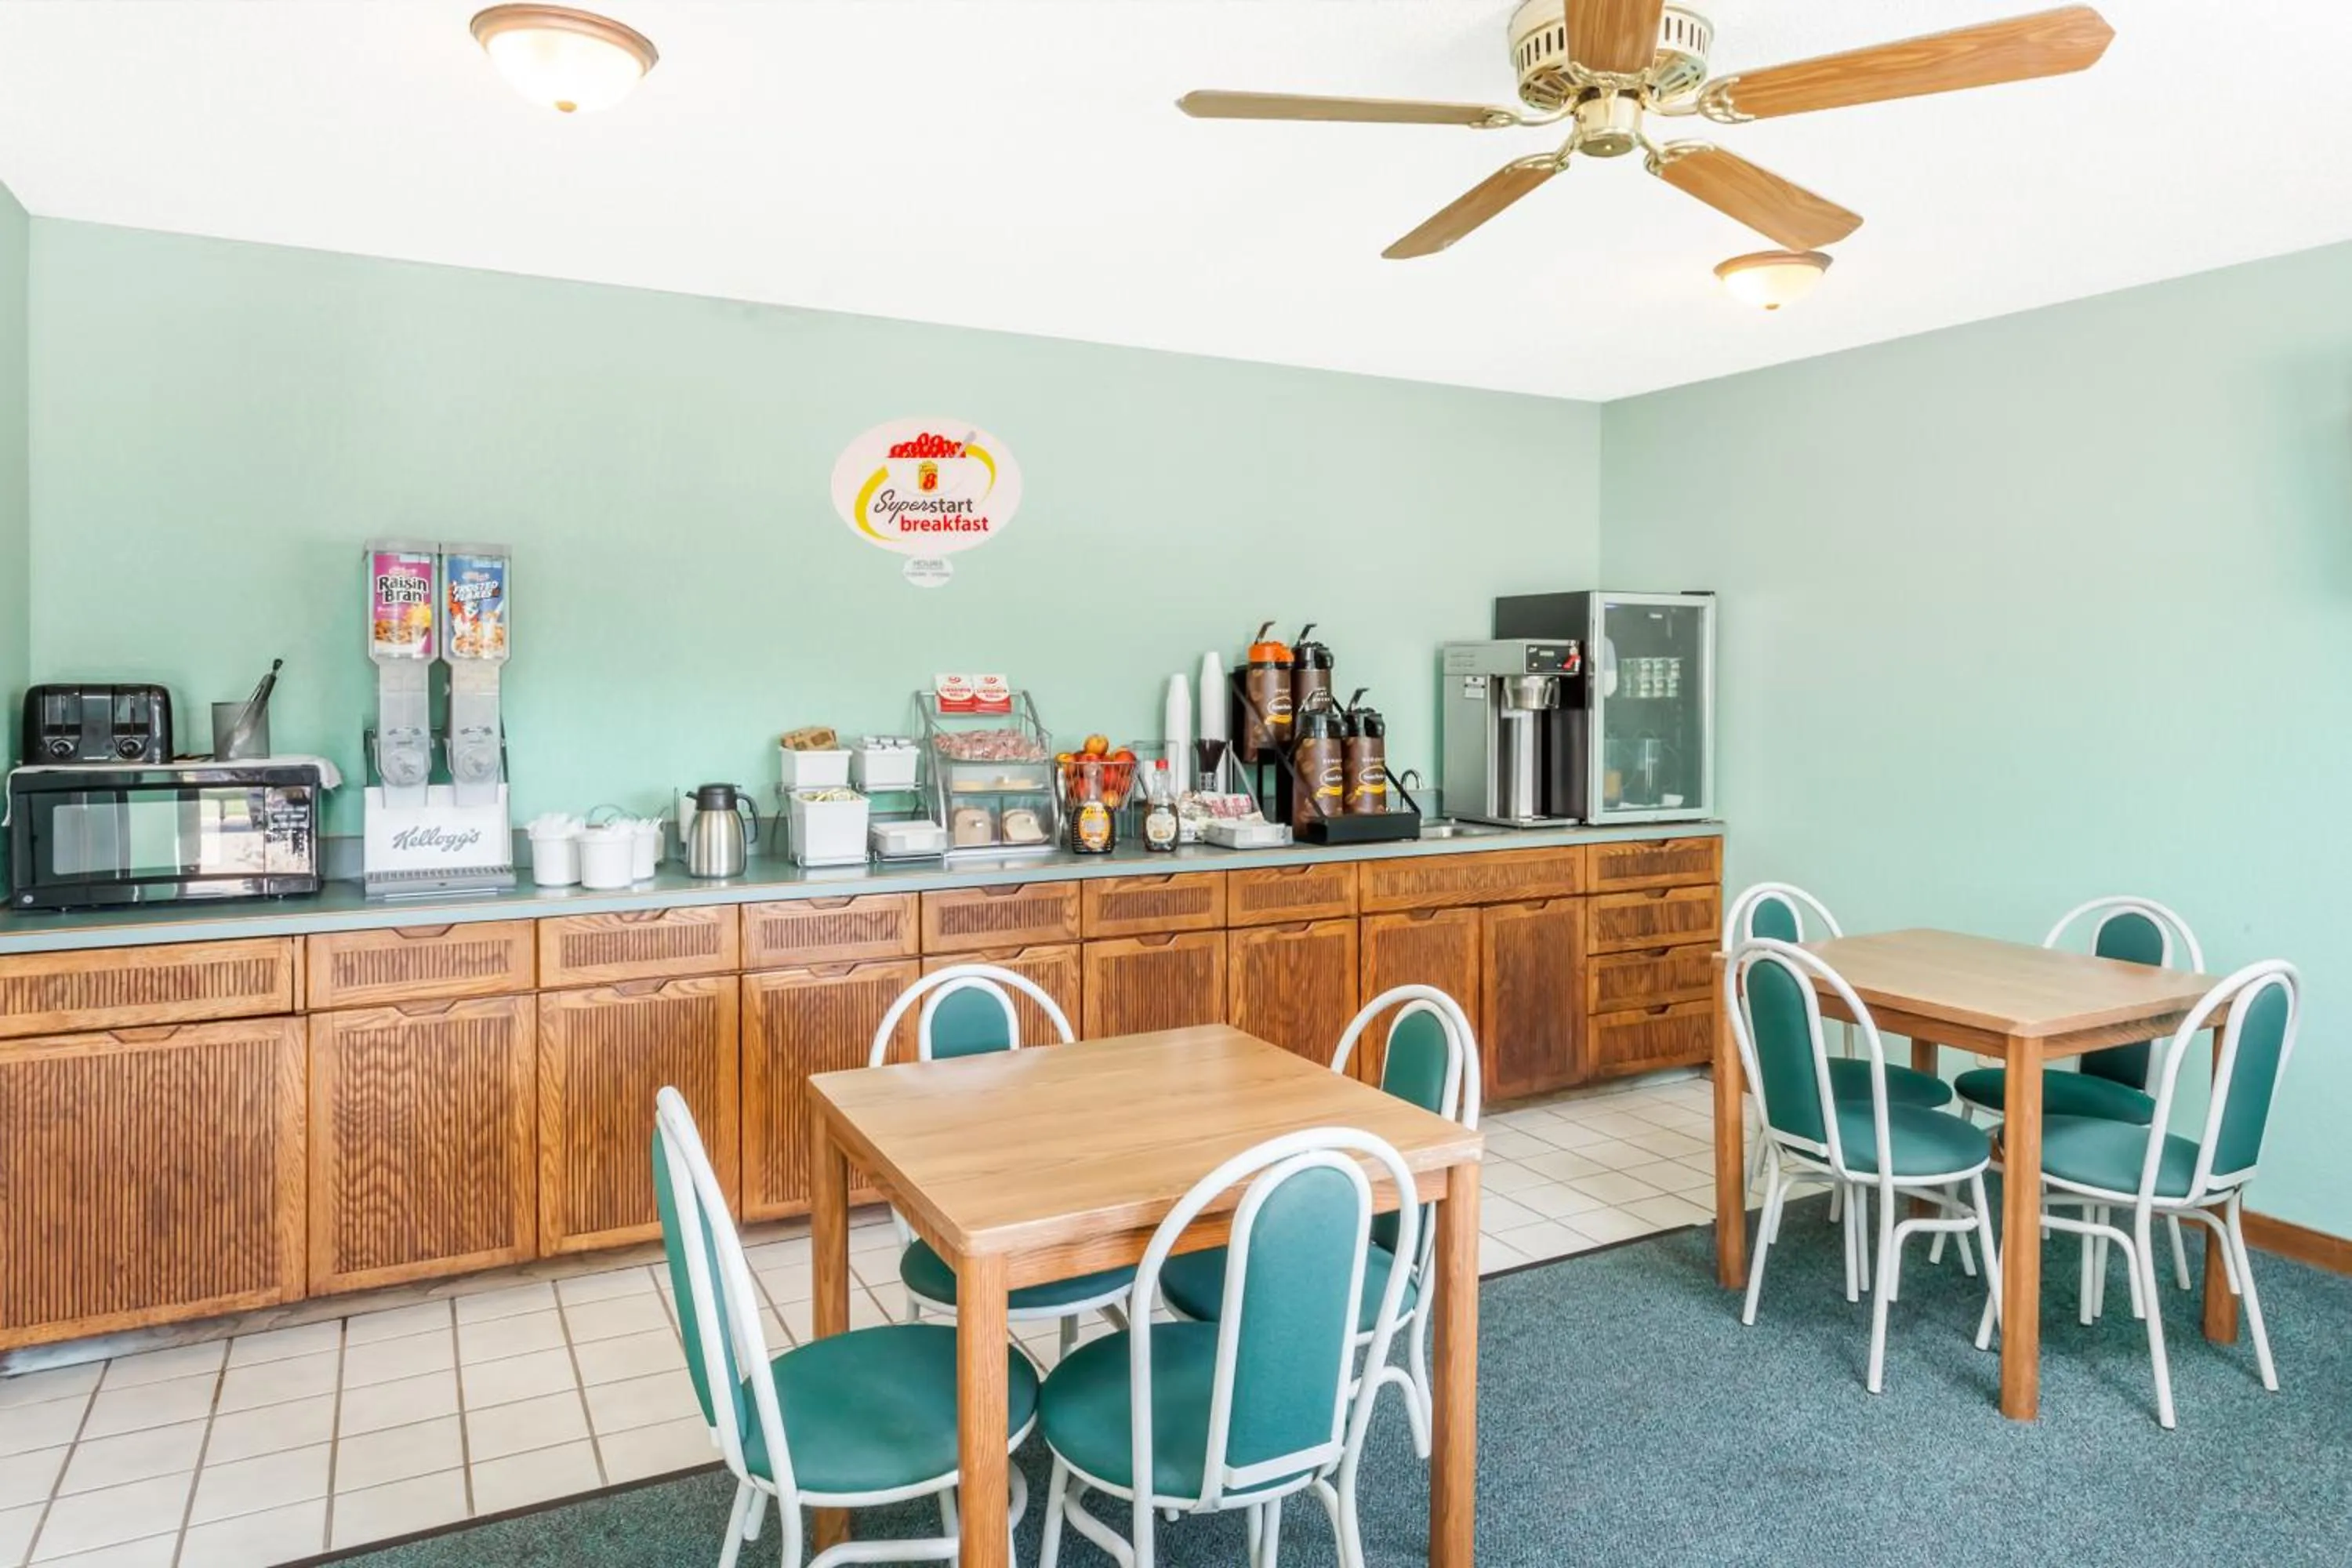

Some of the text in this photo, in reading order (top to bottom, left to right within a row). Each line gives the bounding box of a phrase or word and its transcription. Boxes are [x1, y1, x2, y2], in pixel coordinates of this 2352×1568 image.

[923, 473, 936, 490] 8
[874, 488, 973, 524] Superstart
[900, 514, 989, 532] breakfast
[378, 576, 427, 592] Raisin
[384, 590, 423, 602] Bran
[393, 826, 481, 852] Kellogg's
